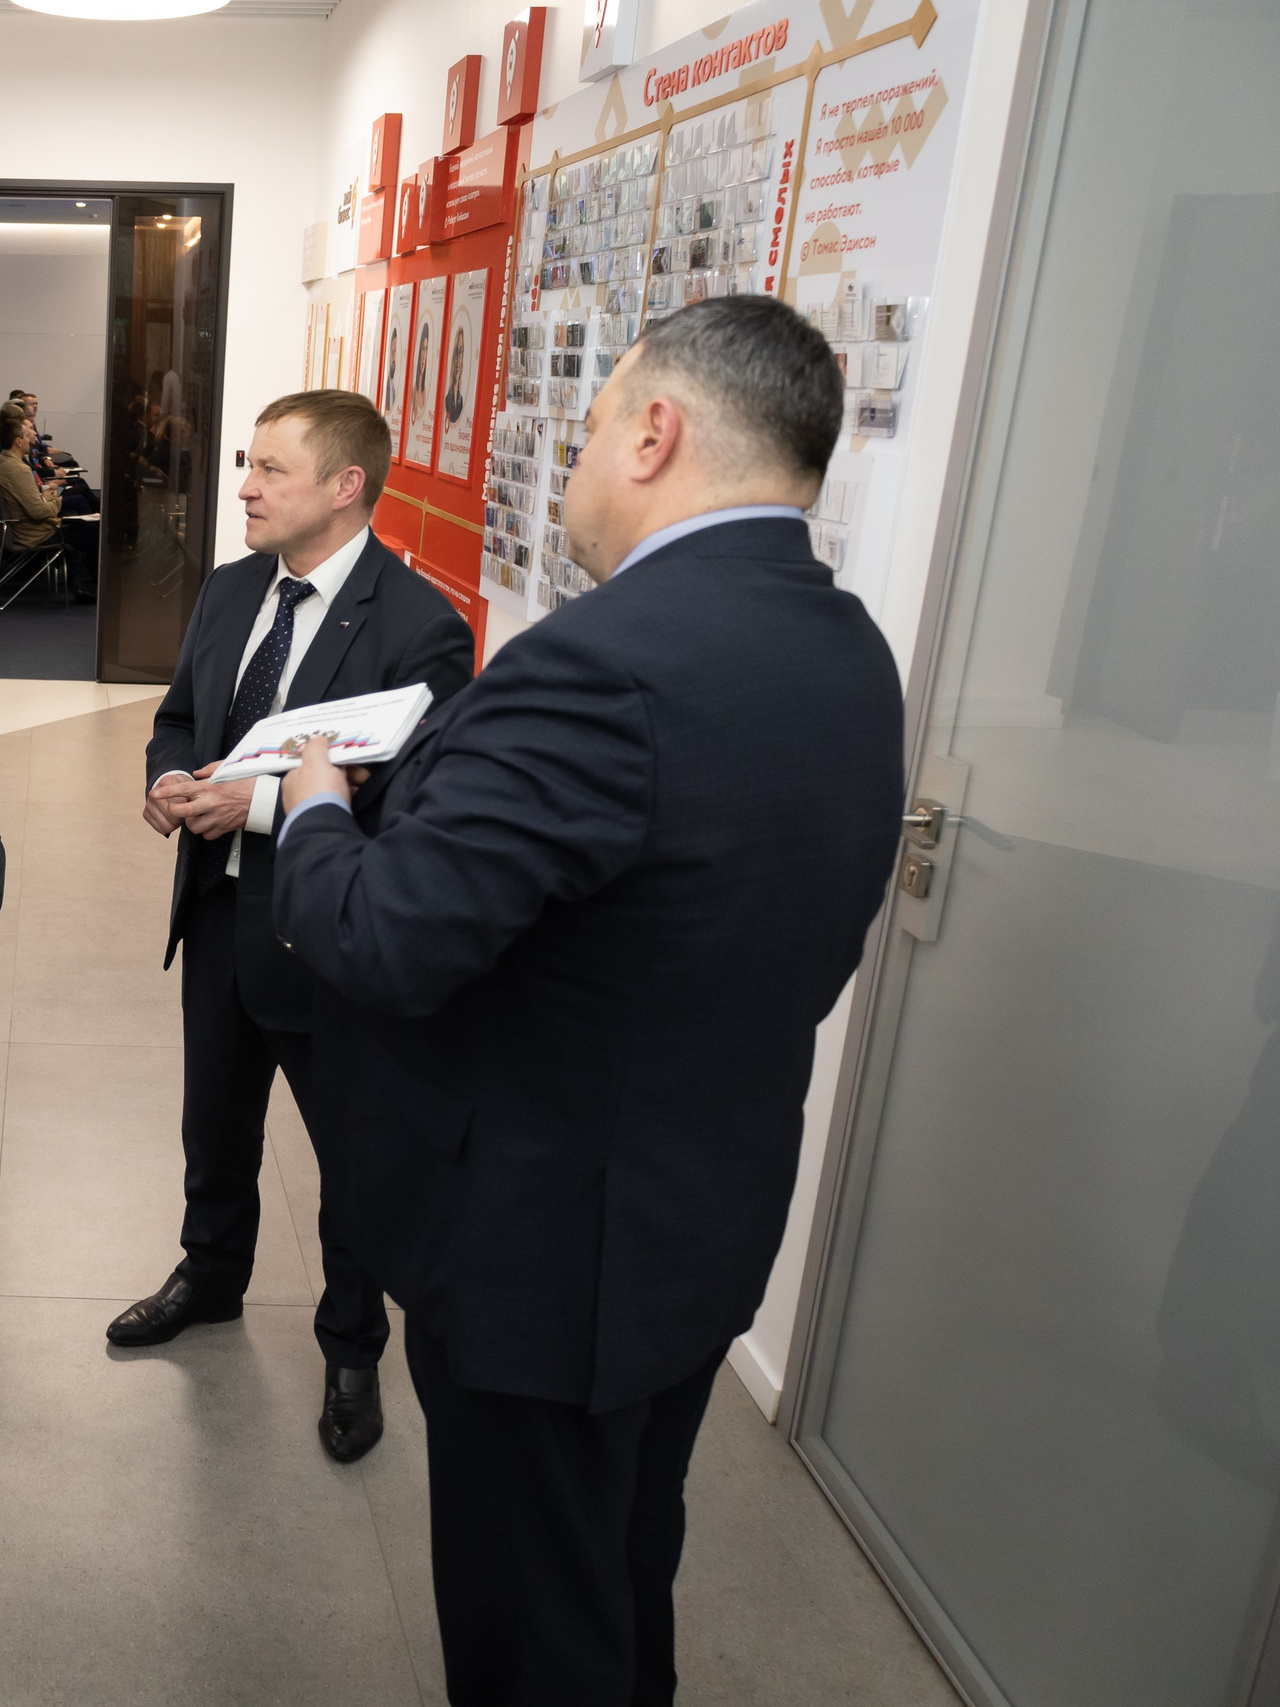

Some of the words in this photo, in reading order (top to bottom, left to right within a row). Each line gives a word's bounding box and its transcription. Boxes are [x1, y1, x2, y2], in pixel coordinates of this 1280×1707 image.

[643, 64, 689, 107] Стена
[691, 17, 790, 89] контактов
[819, 103, 828, 121] Я
[829, 104, 840, 119] не
[841, 95, 874, 120] терпел
[875, 68, 939, 109] поражений,
[815, 138, 823, 156] Я
[824, 132, 855, 157] просто
[856, 122, 889, 147] нашёл
[890, 116, 902, 136] 10
[903, 109, 924, 134] 000
[810, 166, 855, 191] способов,
[856, 157, 901, 184] которые
[804, 210, 816, 224] не
[817, 201, 862, 227] работают.
[811, 236, 839, 257] Томас
[840, 233, 877, 254] Эдисон
